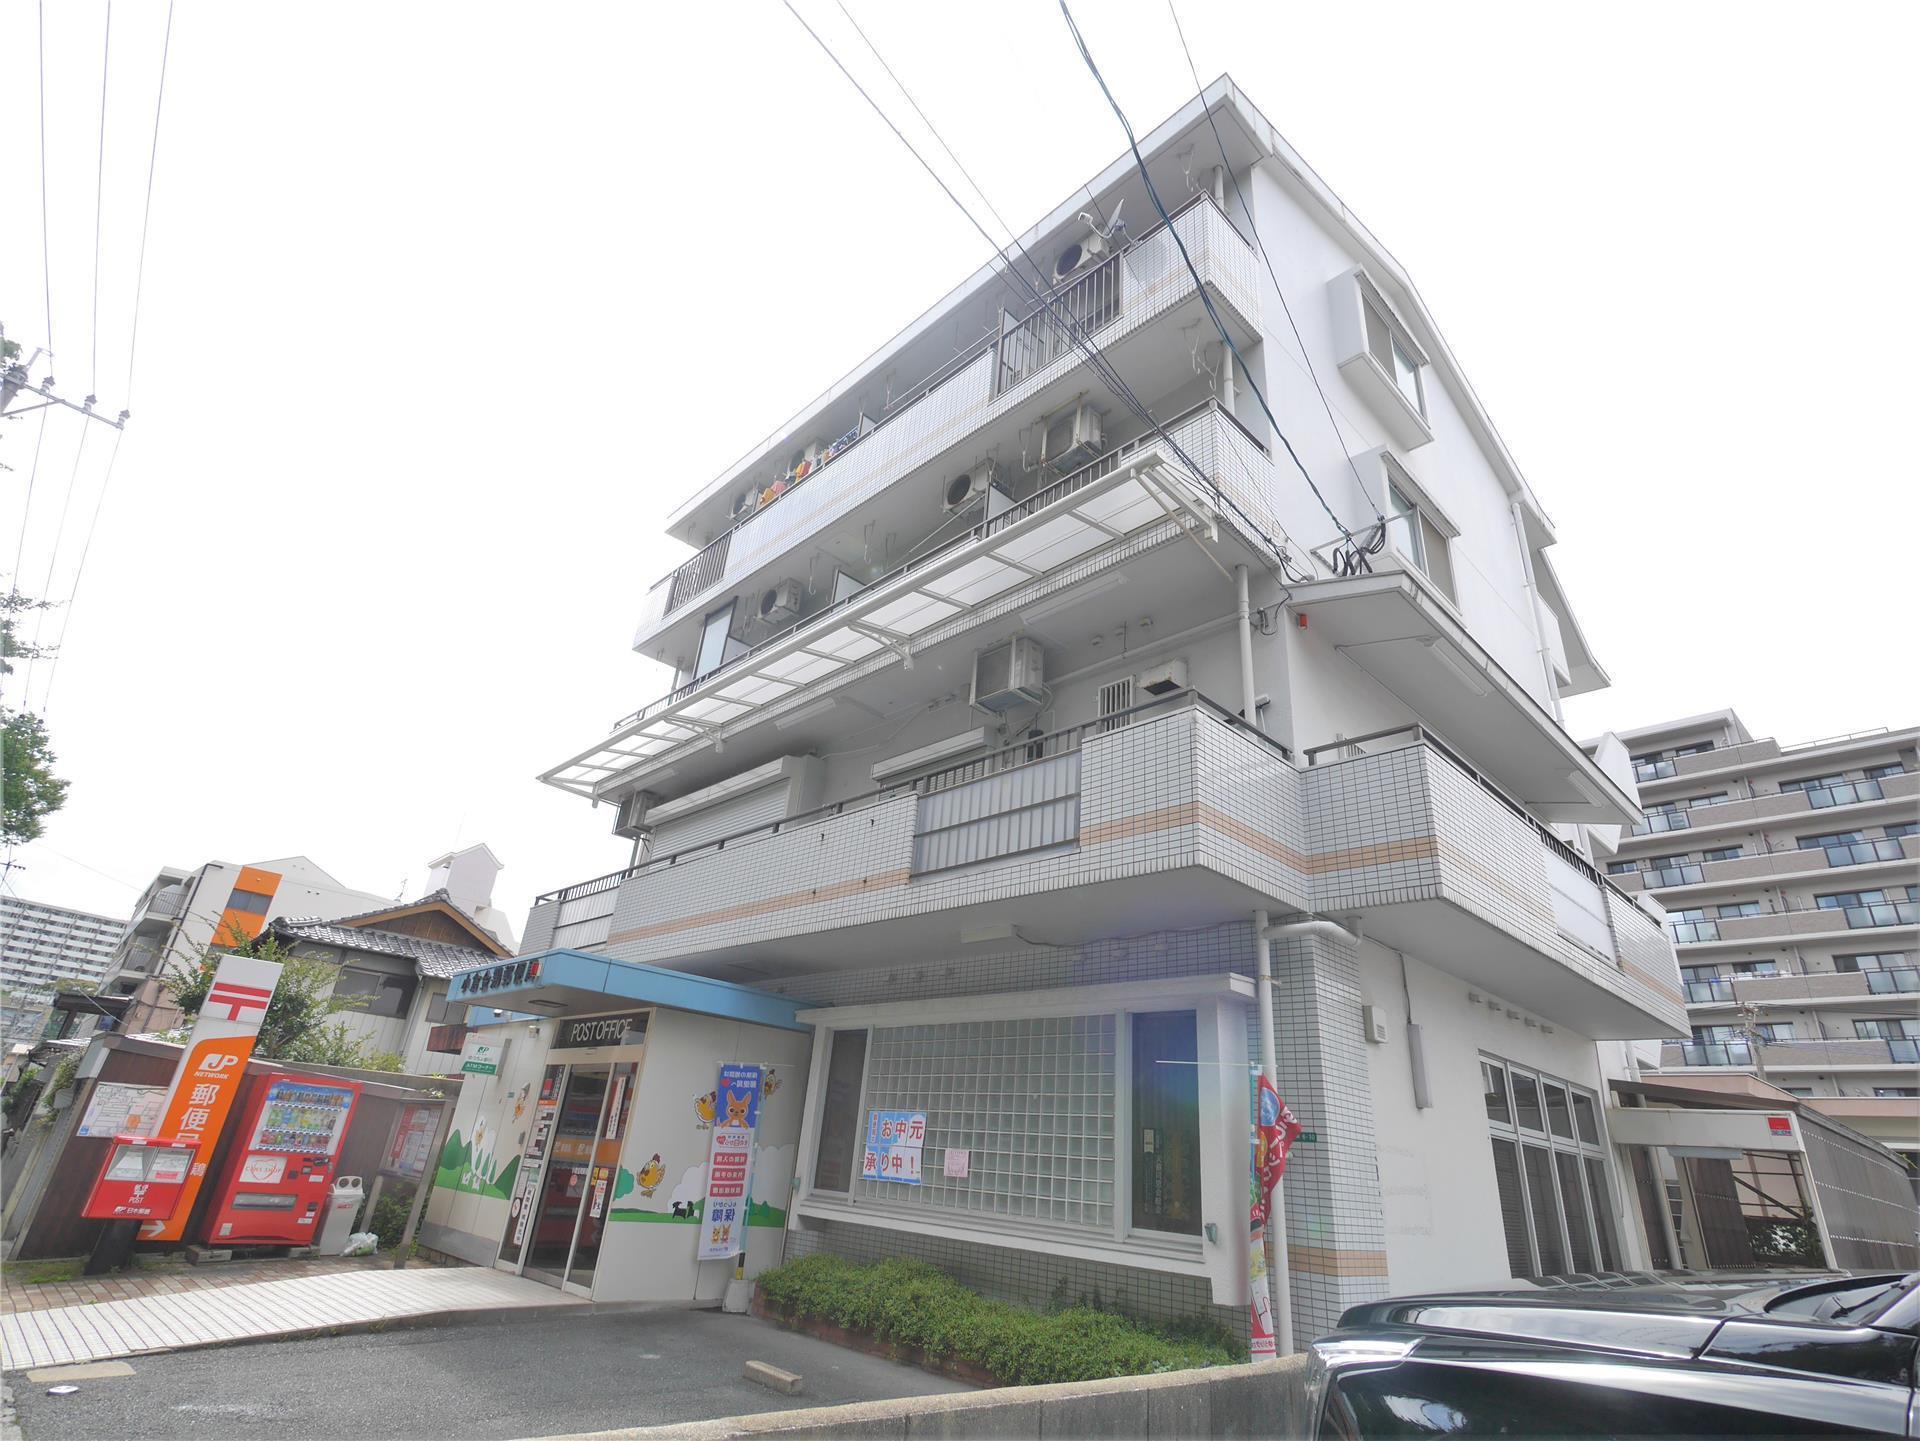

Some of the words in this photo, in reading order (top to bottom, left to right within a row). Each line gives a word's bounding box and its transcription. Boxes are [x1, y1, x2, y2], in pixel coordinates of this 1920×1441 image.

[570, 1021, 598, 1042] POST
[595, 1018, 633, 1040] OFFICE
[194, 1071, 230, 1080] NETWORK
[881, 1119, 924, 1140] お中元
[864, 1152, 915, 1175] 承り中！
[128, 1196, 144, 1204] POST
